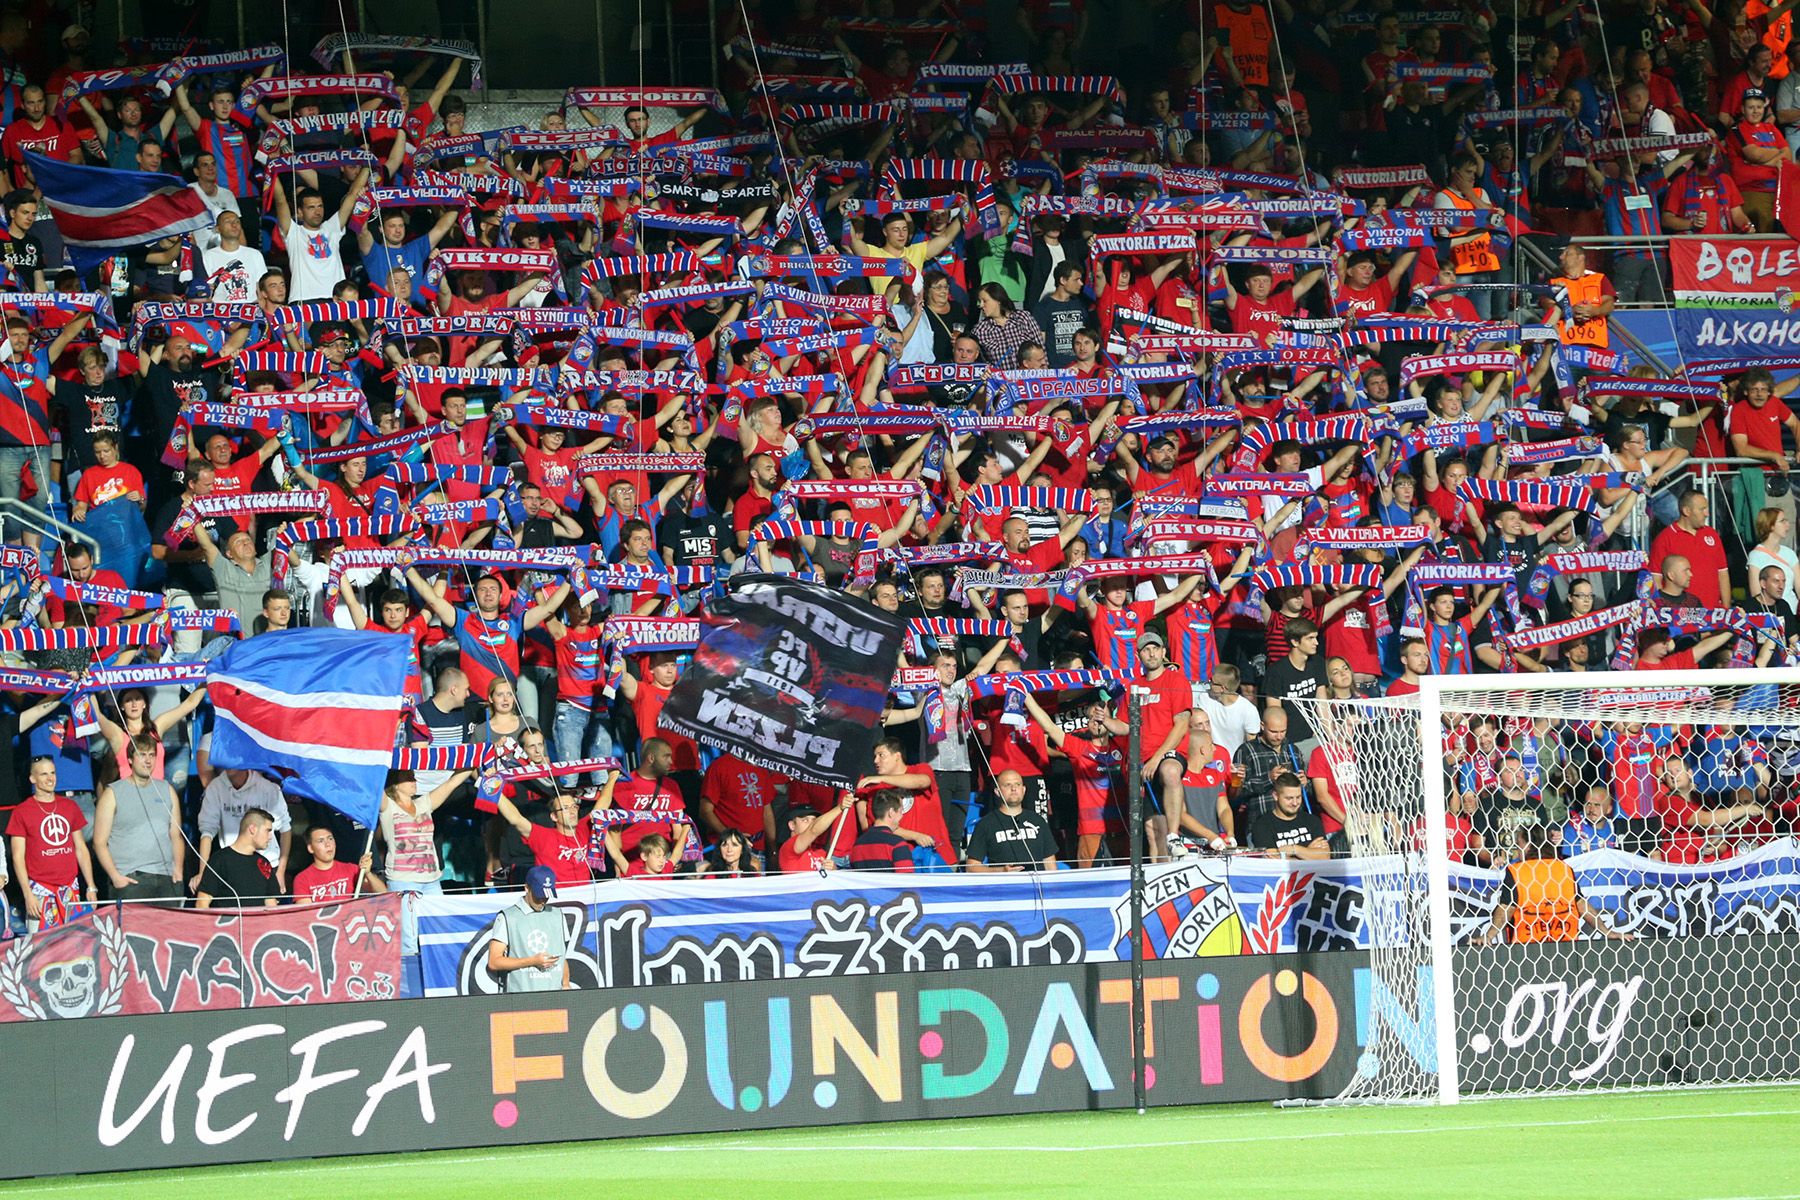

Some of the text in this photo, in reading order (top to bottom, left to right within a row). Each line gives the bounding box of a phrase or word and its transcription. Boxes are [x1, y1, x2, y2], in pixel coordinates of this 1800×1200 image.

[920, 64, 995, 78] FC VIKTORIA
[257, 77, 383, 94] VIKTORIA
[580, 92, 708, 102] VIKTORIA
[1214, 111, 1271, 121] VIKTORIA
[430, 134, 482, 151] VIKTORIA
[283, 152, 338, 169] VIKTORIA
[1345, 171, 1396, 186] VIKTORIA
[662, 182, 772, 199] SMRT SPARTĚ
[1250, 200, 1313, 214] VIKTORIA
[1395, 211, 1413, 219] FC
[1414, 209, 1477, 219] VIKTORIA
[1146, 215, 1256, 226] VIKTORIA
[1347, 228, 1424, 241] FC VIKTORIA
[1098, 238, 1156, 253] VIKTORIA
[779, 262, 825, 270] BRIGADE
[863, 262, 887, 270] BOYS
[651, 284, 712, 301] VIKTORIA
[789, 288, 837, 305] VIKTORIA
[1684, 293, 1775, 307] FC VIKTORIA
[534, 310, 573, 323] SYNOT
[1119, 307, 1132, 319] FC
[386, 317, 509, 332] VIKTORKA
[742, 318, 821, 329] FC VIKTORIA
[1566, 327, 1595, 341] 096
[1137, 337, 1256, 349] VIKTORIA
[1226, 350, 1332, 362] VIKTORIA
[1406, 353, 1512, 373] VIKTORIA
[568, 370, 613, 388] RAS
[239, 392, 361, 409] VIKTORIA
[206, 405, 271, 419] VIKTORIA
[527, 406, 544, 415] FC
[547, 407, 610, 423] VIKTORIA
[1509, 409, 1563, 424] FC VIKTO
[959, 414, 1004, 427] VIKTORIA
[1422, 424, 1480, 437] VIKTORIA
[789, 483, 914, 494] VIKTORIA
[1218, 480, 1271, 492] VIKTORIA
[425, 498, 488, 512] VIKTORIA
[1308, 529, 1324, 541] FC
[1328, 527, 1380, 540] VIKTORIA
[420, 547, 518, 563] FC VIKTORIA
[1554, 553, 1575, 571] FC
[1084, 561, 1206, 573] VIKTORIA
[1417, 566, 1482, 581] VIKTORIA
[1508, 617, 1596, 652] FC VIKTORIA
[94, 666, 172, 684] VIKTORIA
[41, 847, 73, 857] NEPTUN
[1311, 881, 1364, 928] FC
[1171, 896, 1232, 961] TORIA
[98, 964, 1644, 1147] UEFA FOUNDATION .org
